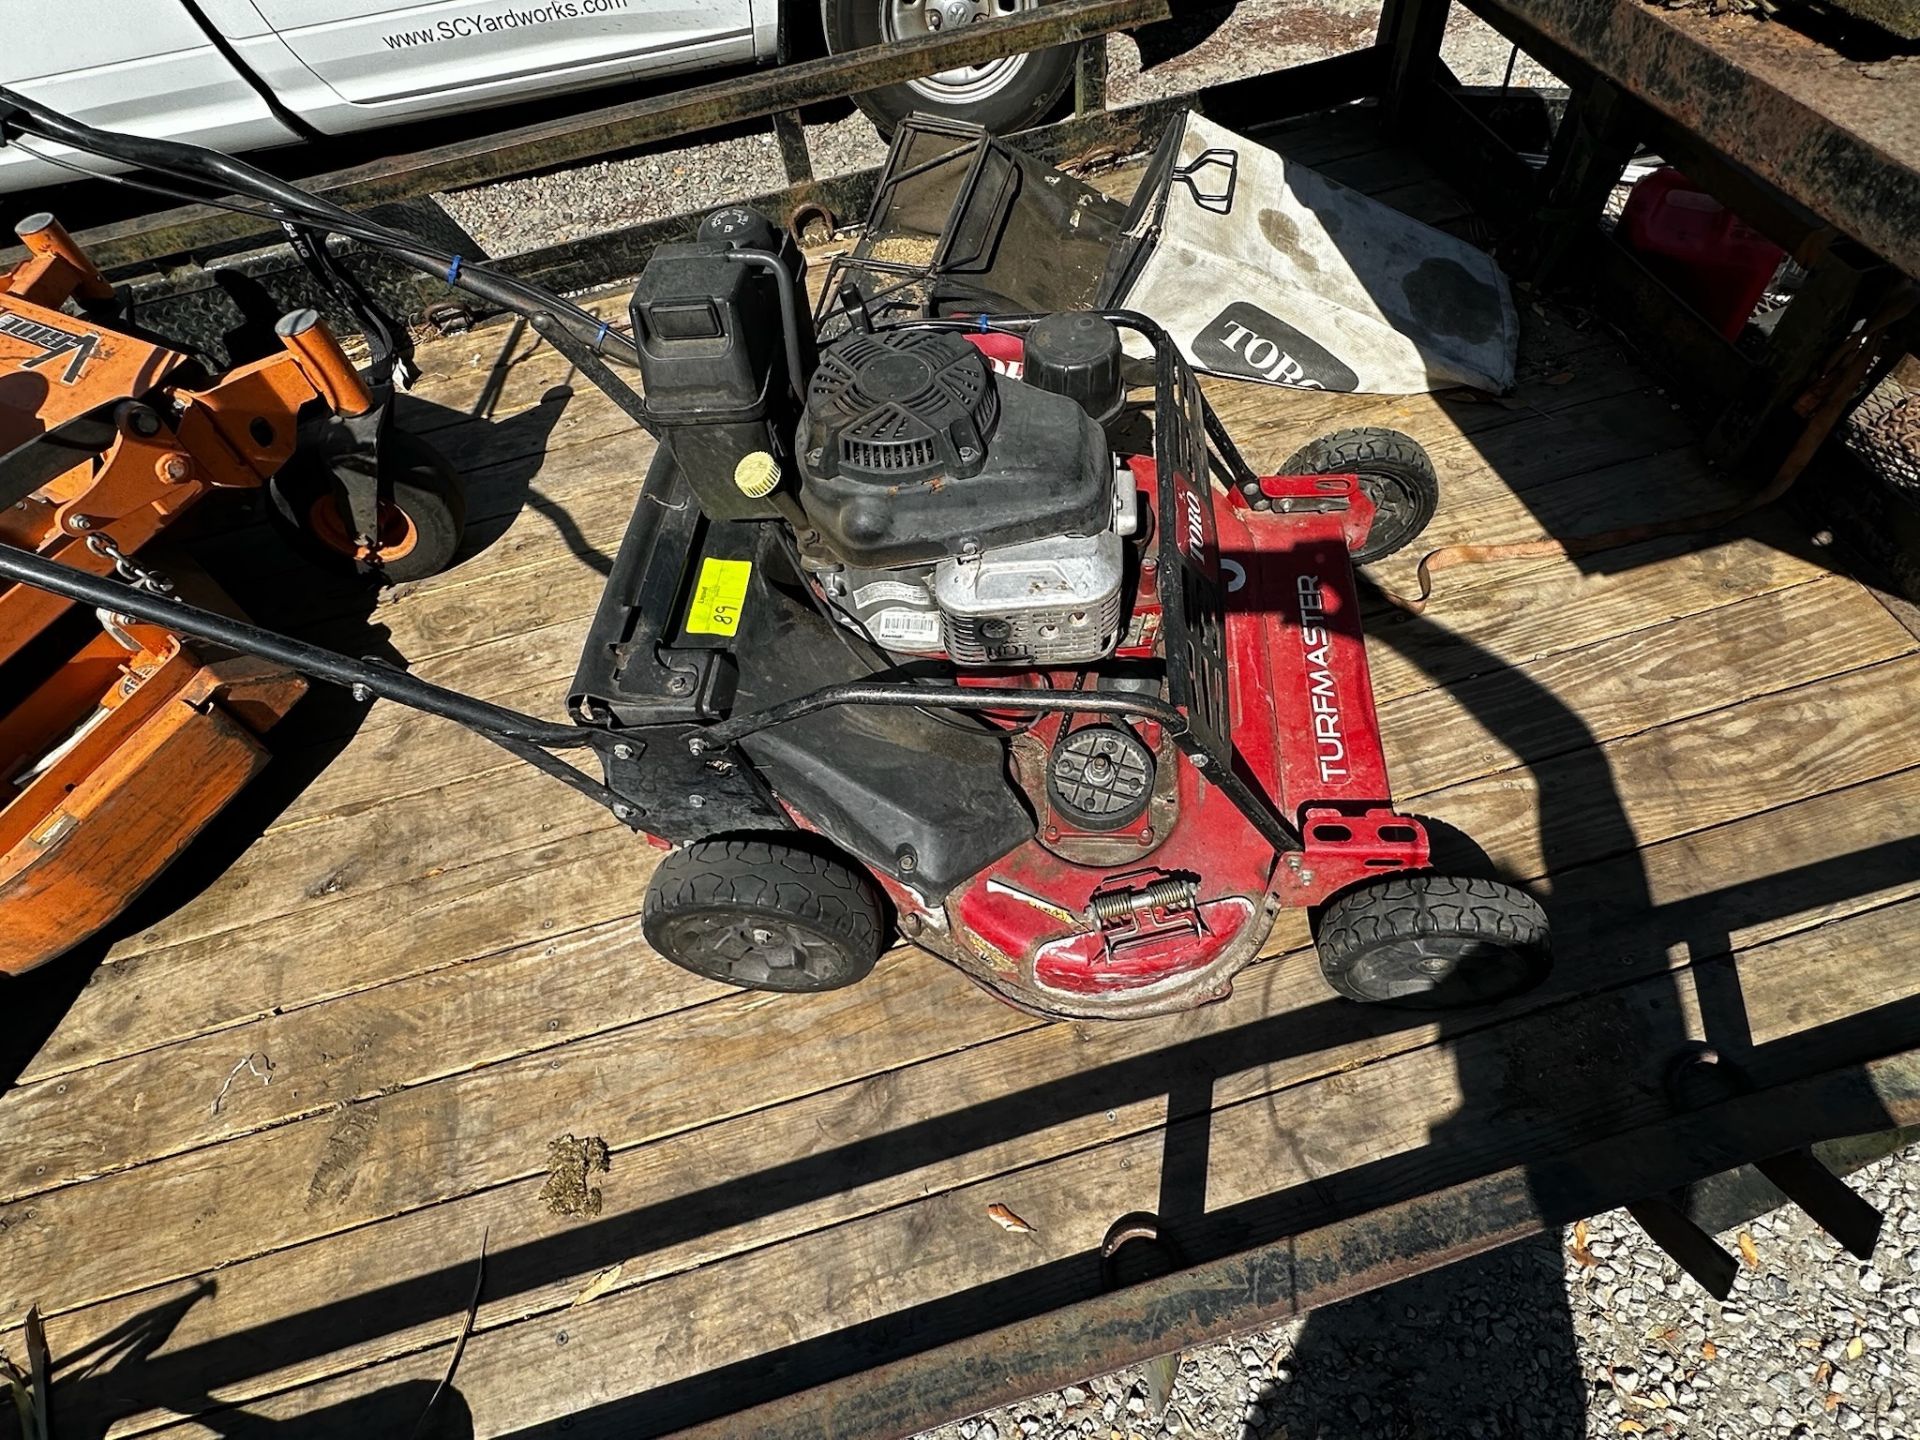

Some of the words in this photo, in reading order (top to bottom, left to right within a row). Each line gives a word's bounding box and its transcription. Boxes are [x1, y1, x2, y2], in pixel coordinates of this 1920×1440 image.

[382, 0, 628, 50] www.SCYardworks.com
[1186, 490, 1206, 566] TORO
[713, 605, 739, 625] 89
[1297, 575, 1347, 783] TURFMASTER
